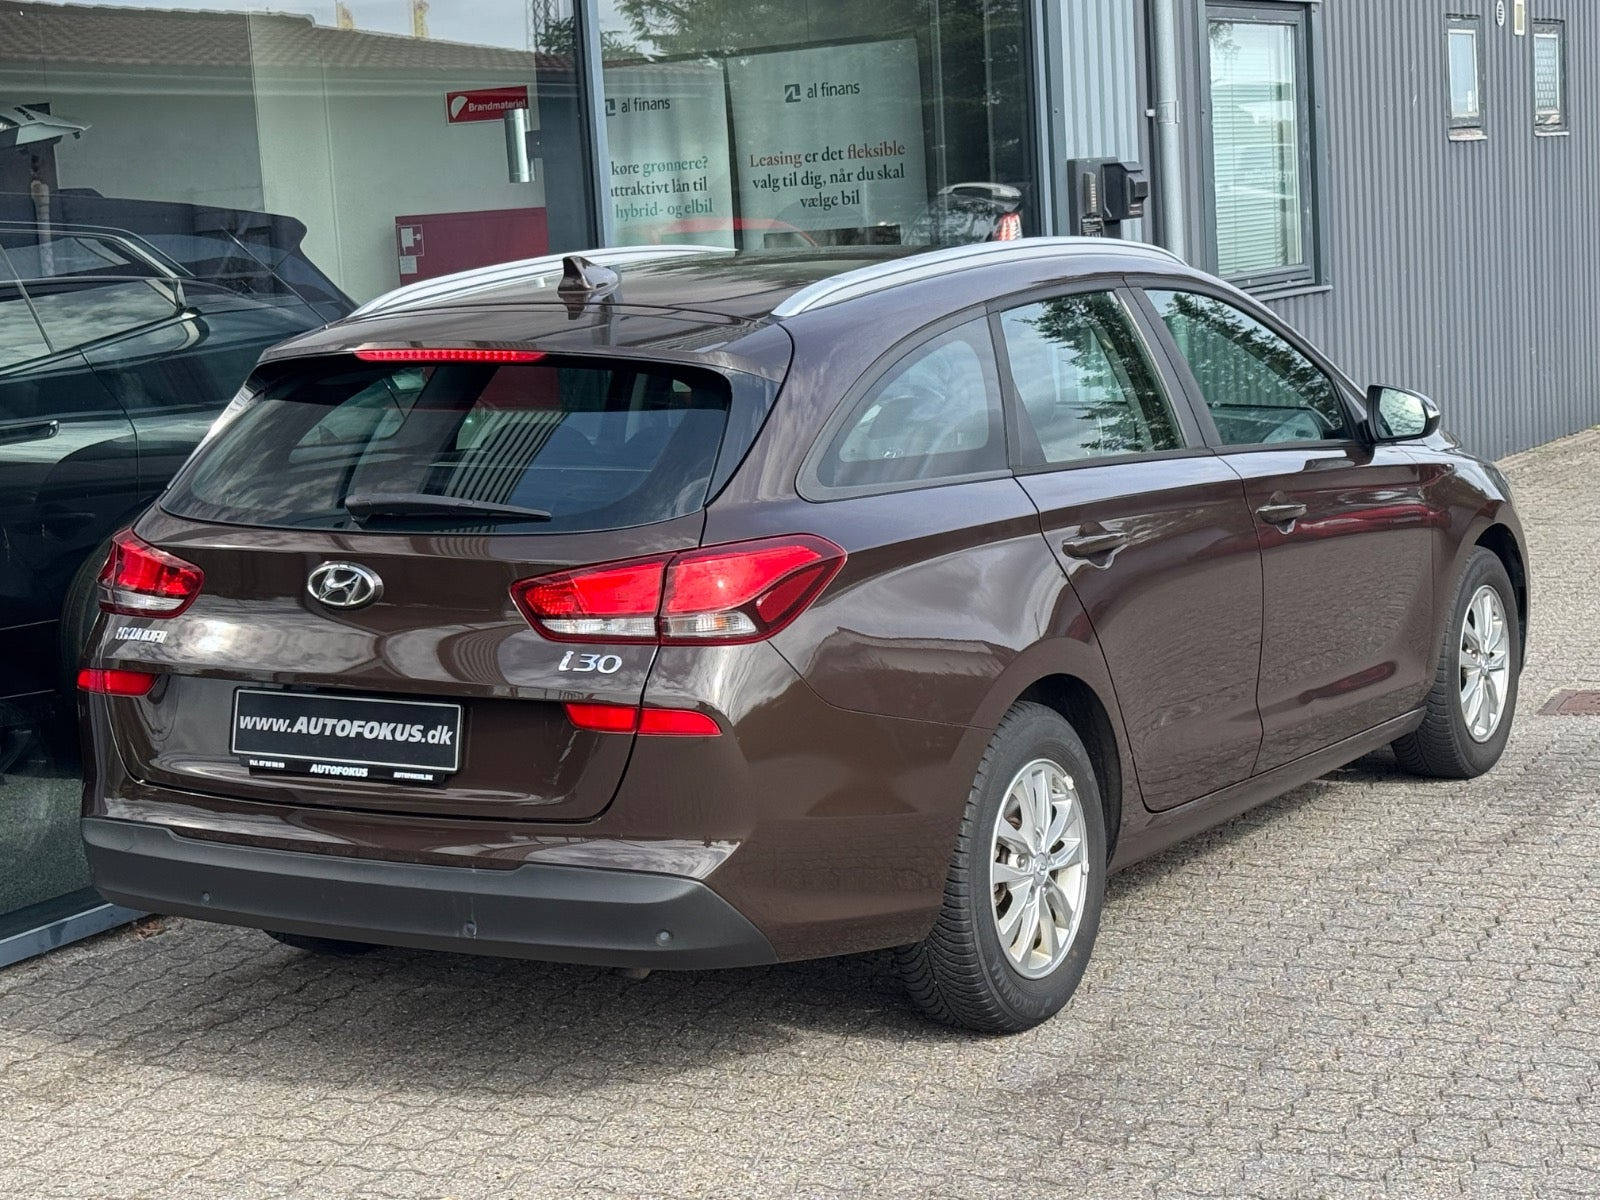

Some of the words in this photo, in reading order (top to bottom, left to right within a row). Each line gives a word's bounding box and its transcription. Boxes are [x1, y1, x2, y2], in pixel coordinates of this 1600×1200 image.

[807, 83, 817, 98] al
[821, 82, 860, 97] finans
[468, 98, 526, 112] Brandmateriel
[621, 98, 631, 113] al
[634, 97, 671, 112] finans
[750, 151, 802, 168] Leasing
[804, 152, 818, 163] er
[821, 146, 844, 161] det
[847, 140, 905, 160] fleksible
[611, 161, 640, 176] køre
[642, 156, 708, 177] grønnere?
[752, 173, 780, 192] valg
[783, 172, 797, 187] til
[801, 170, 826, 189] dig,
[829, 168, 853, 184] når
[857, 166, 874, 182] du
[877, 162, 905, 180] skal
[611, 181, 670, 197] ttraktivt
[672, 178, 690, 193] lån
[693, 176, 708, 191] til
[615, 201, 664, 222] hybrid-
[667, 204, 683, 219] og
[684, 198, 713, 214] elbil
[800, 192, 838, 211] vælge
[841, 189, 860, 205] bil
[115, 626, 168, 644] HYUNDAI
[558, 650, 623, 674] i30
[239, 715, 453, 745] www.AUTOFOKUS.dk
[310, 763, 368, 778] AUTOFOKUS
